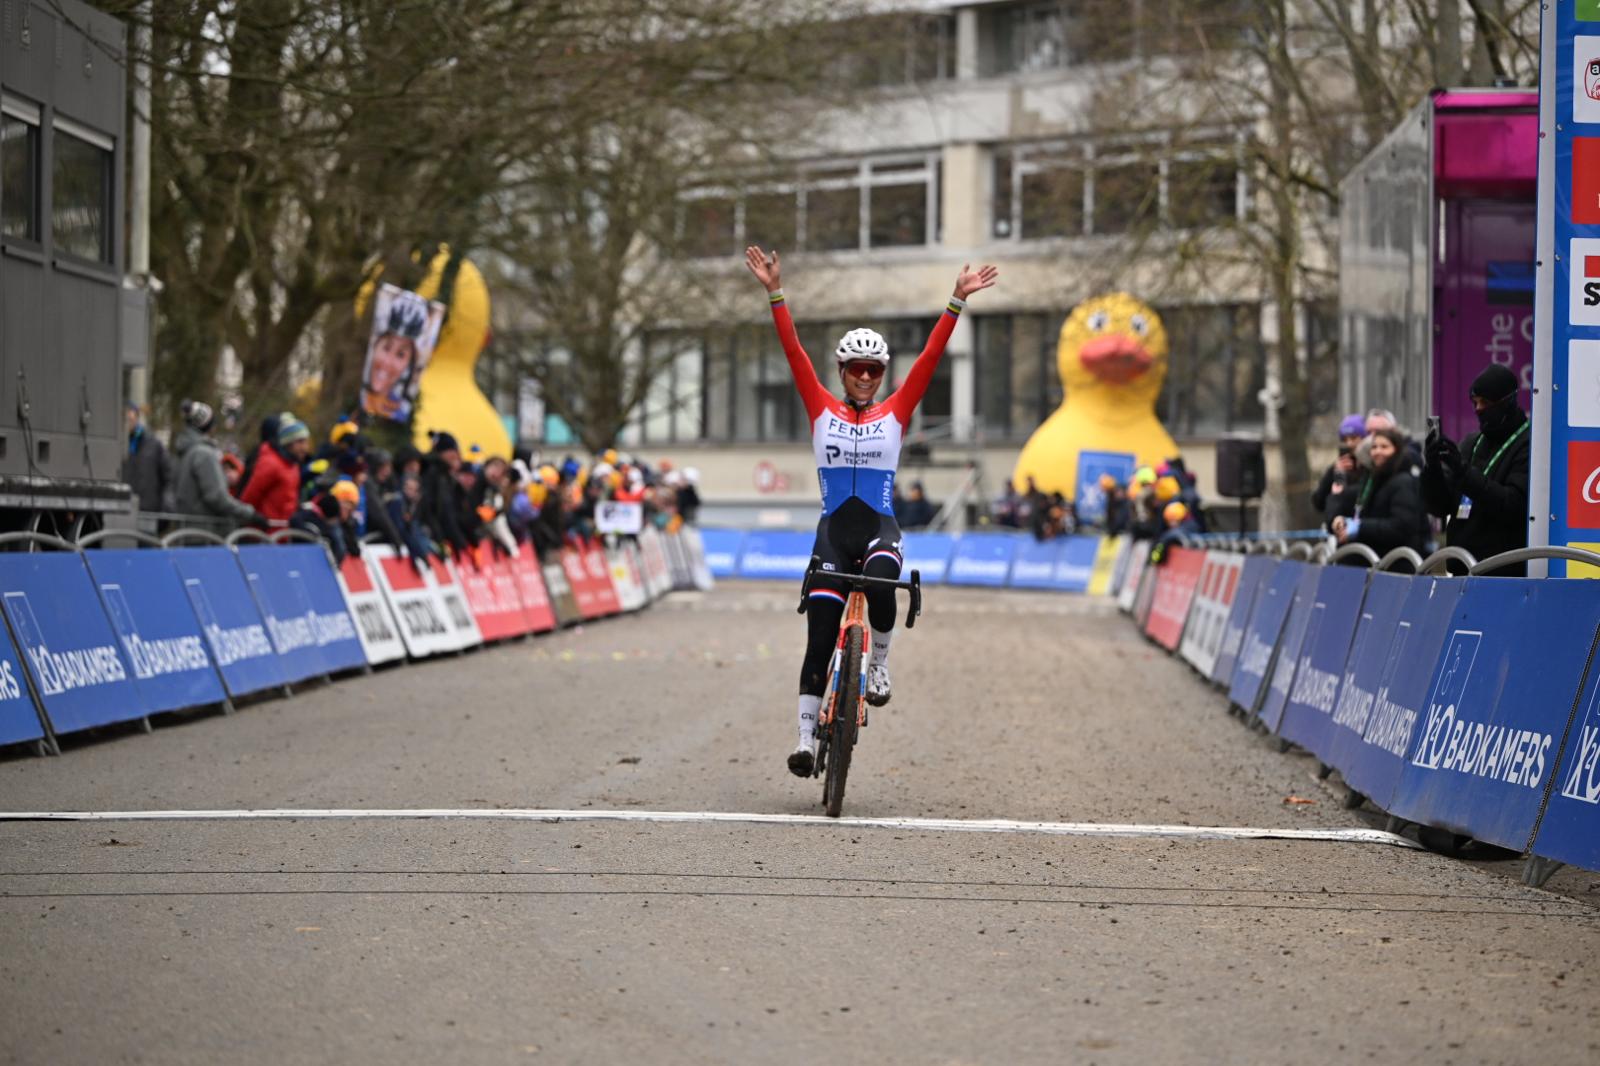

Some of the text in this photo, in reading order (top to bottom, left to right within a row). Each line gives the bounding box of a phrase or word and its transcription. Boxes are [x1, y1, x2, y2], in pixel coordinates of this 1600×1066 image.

[829, 418, 884, 437] FENIX
[882, 473, 892, 508] FENIX
[53, 645, 128, 690] BADKAMERS
[1442, 720, 1552, 789] BADKAMERS
